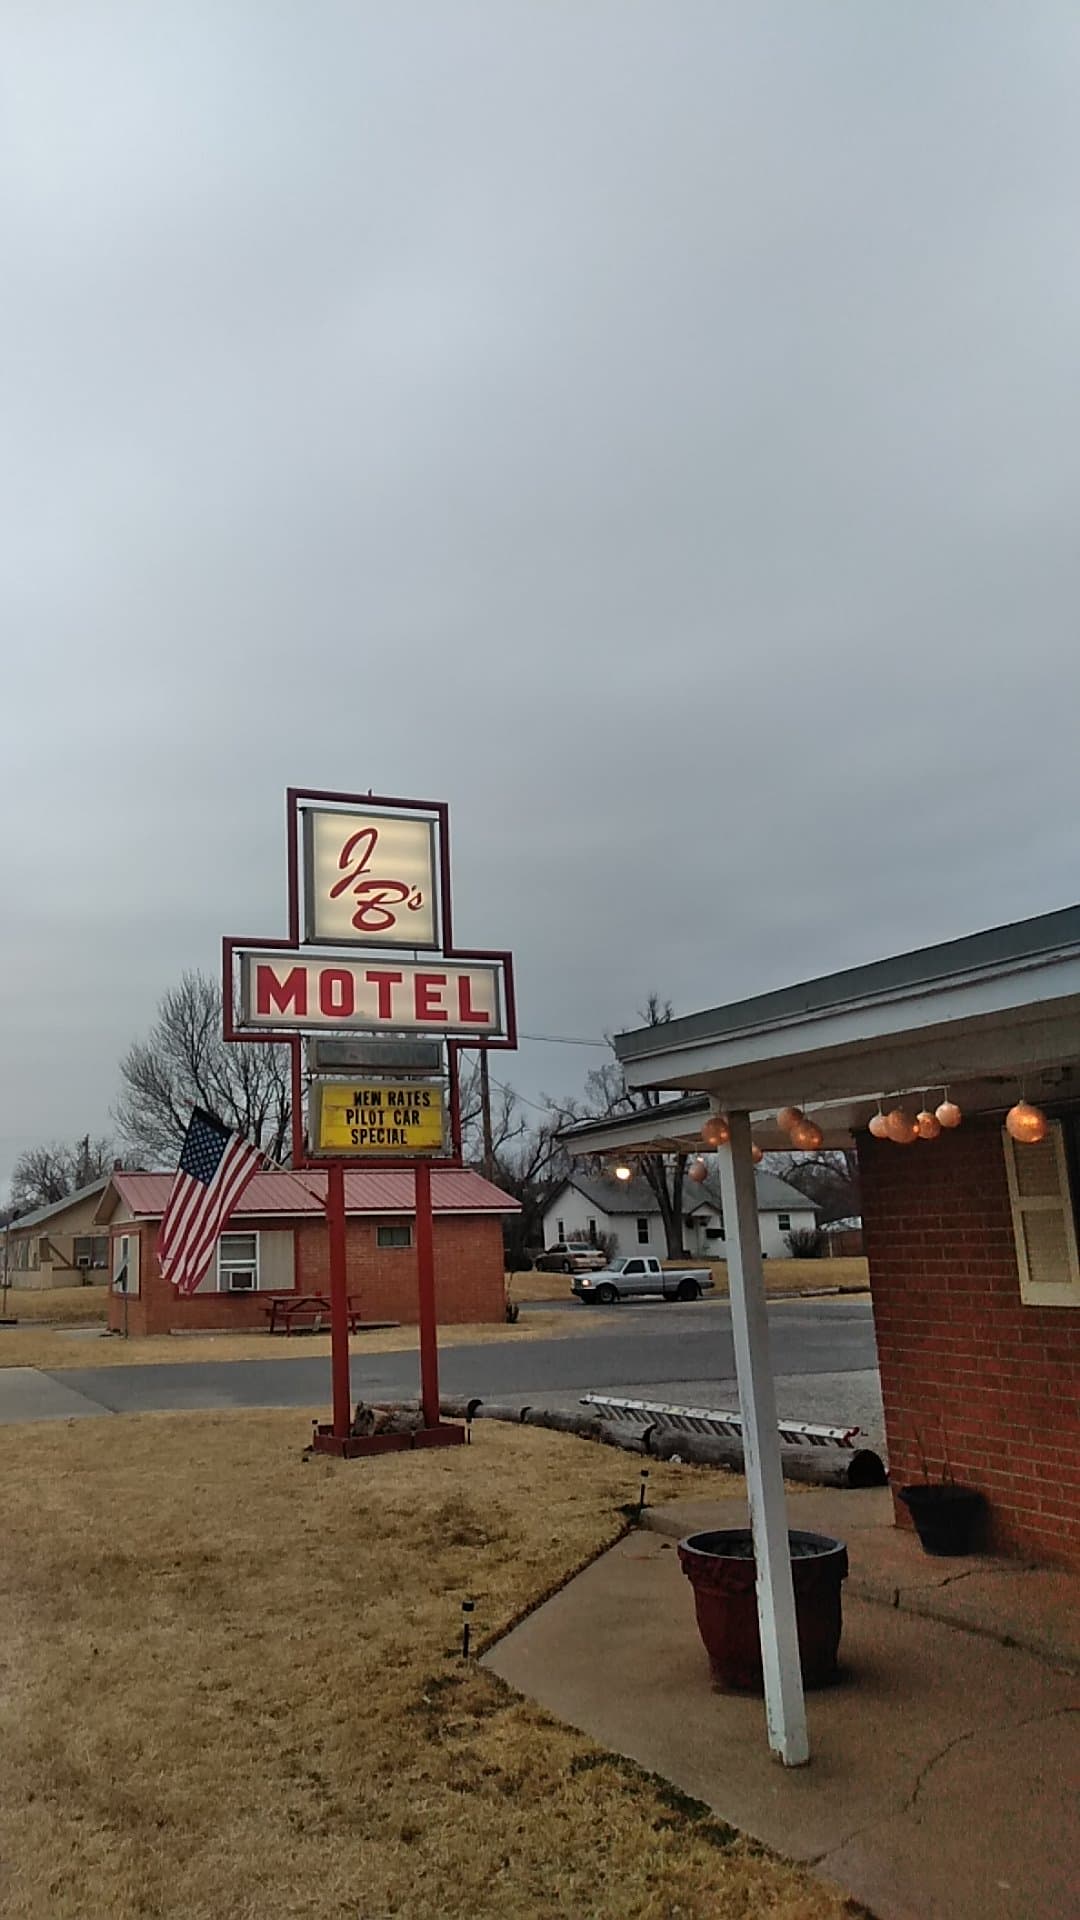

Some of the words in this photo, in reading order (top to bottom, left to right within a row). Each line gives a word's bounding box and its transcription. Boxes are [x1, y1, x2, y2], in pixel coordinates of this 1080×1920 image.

[256, 964, 490, 1023] MOTEL
[387, 1090, 431, 1107] RATES
[345, 1109, 385, 1125] PILOT
[393, 1110, 420, 1126] CAR
[351, 1128, 408, 1145] SPECIAL
